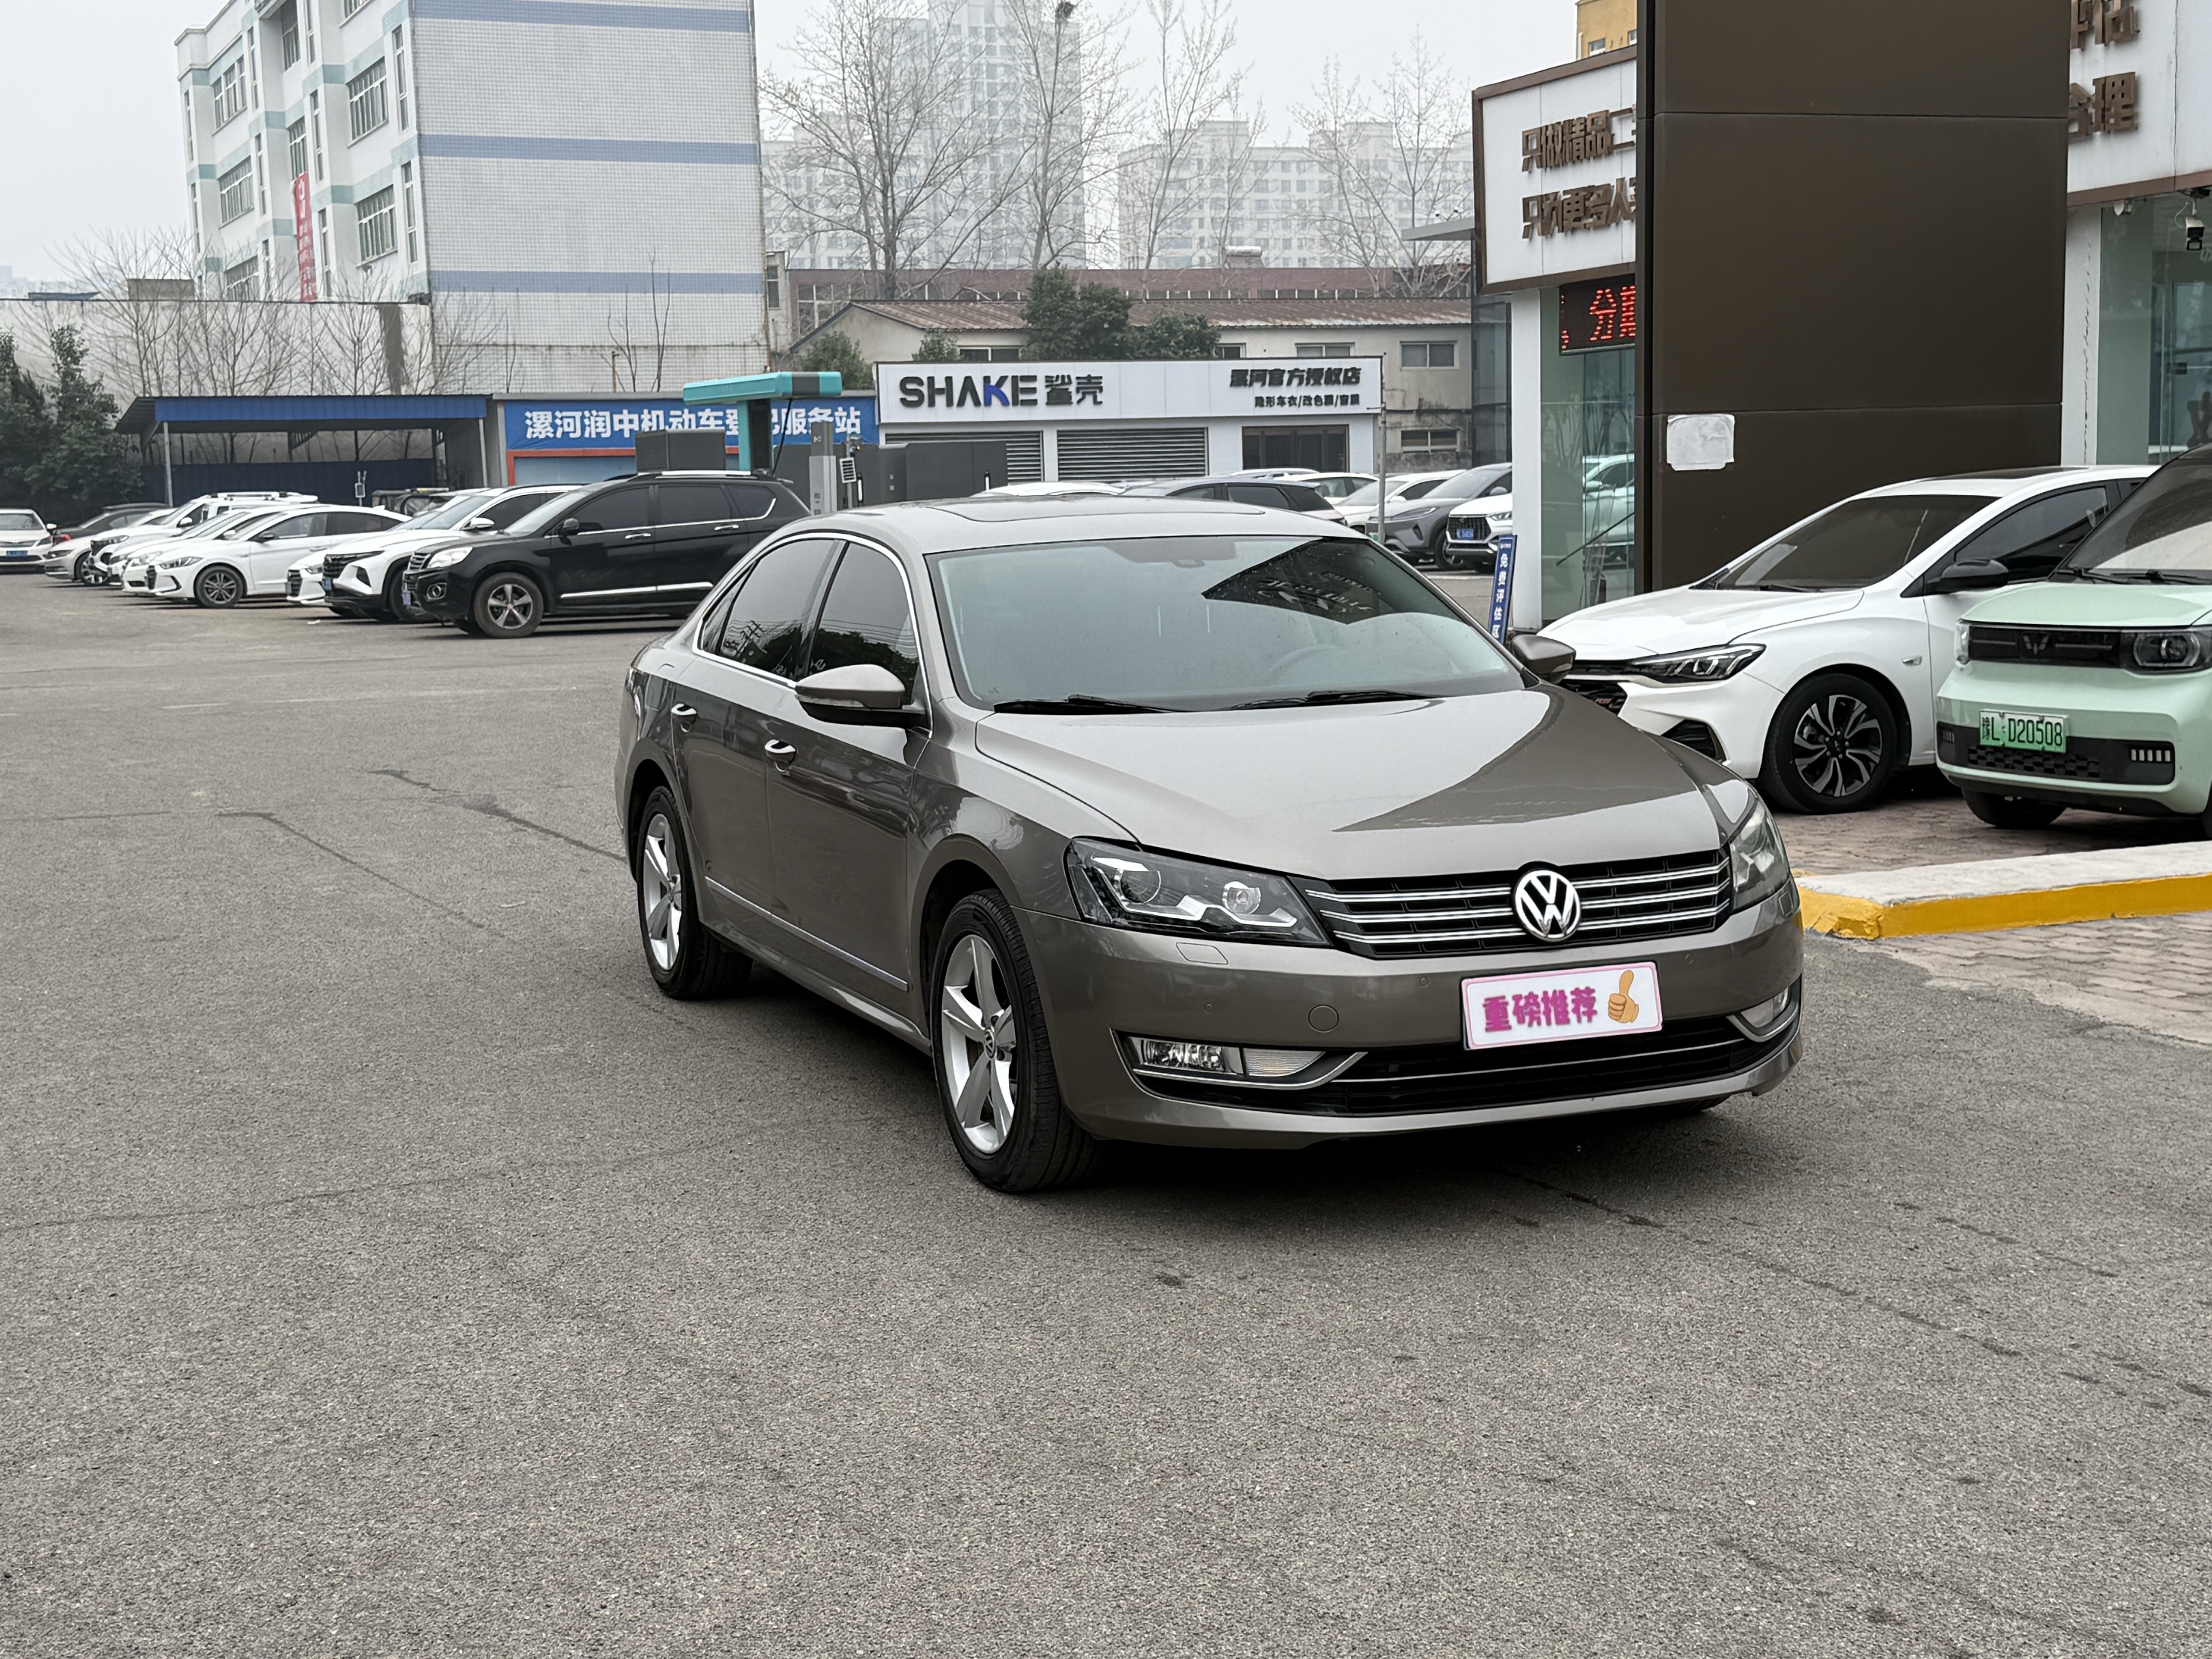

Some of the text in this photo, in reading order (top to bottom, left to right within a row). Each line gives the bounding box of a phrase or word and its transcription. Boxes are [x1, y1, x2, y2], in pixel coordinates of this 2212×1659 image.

[1522, 104, 1636, 173] 只做精品二
[1522, 177, 1636, 239] 只为更多人
[900, 374, 1103, 408] SHAKE 鲨壳
[1515, 869, 1581, 941] VW
[1482, 986, 1597, 1032] 重磅推荐
